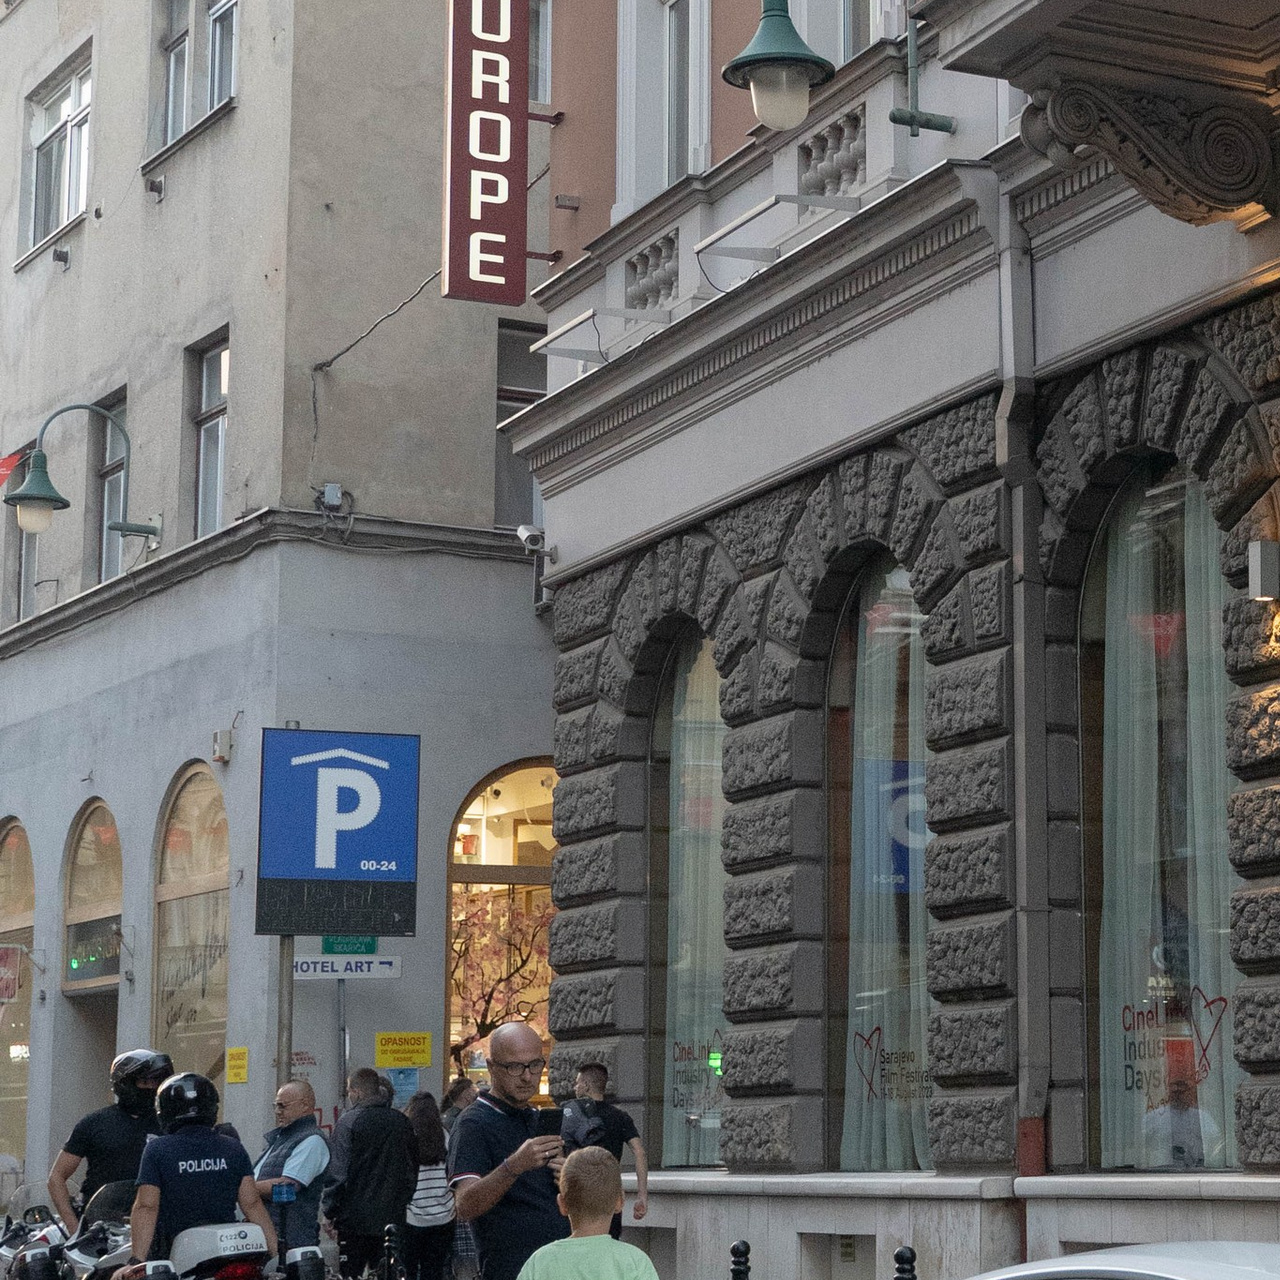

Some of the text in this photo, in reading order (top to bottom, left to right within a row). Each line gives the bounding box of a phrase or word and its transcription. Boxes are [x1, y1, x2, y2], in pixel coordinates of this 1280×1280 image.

[315, 767, 381, 869] P
[360, 860, 397, 871] 00-24
[293, 961, 374, 973] HOTEL ART
[380, 1036, 427, 1047] OPASNOST
[880, 1048, 915, 1067] Sarajevo
[881, 1067, 898, 1084] Film
[1124, 1064, 1162, 1096] Days
[178, 1158, 228, 1174] POLICIJA
[222, 1243, 265, 1253] POLICIJA
